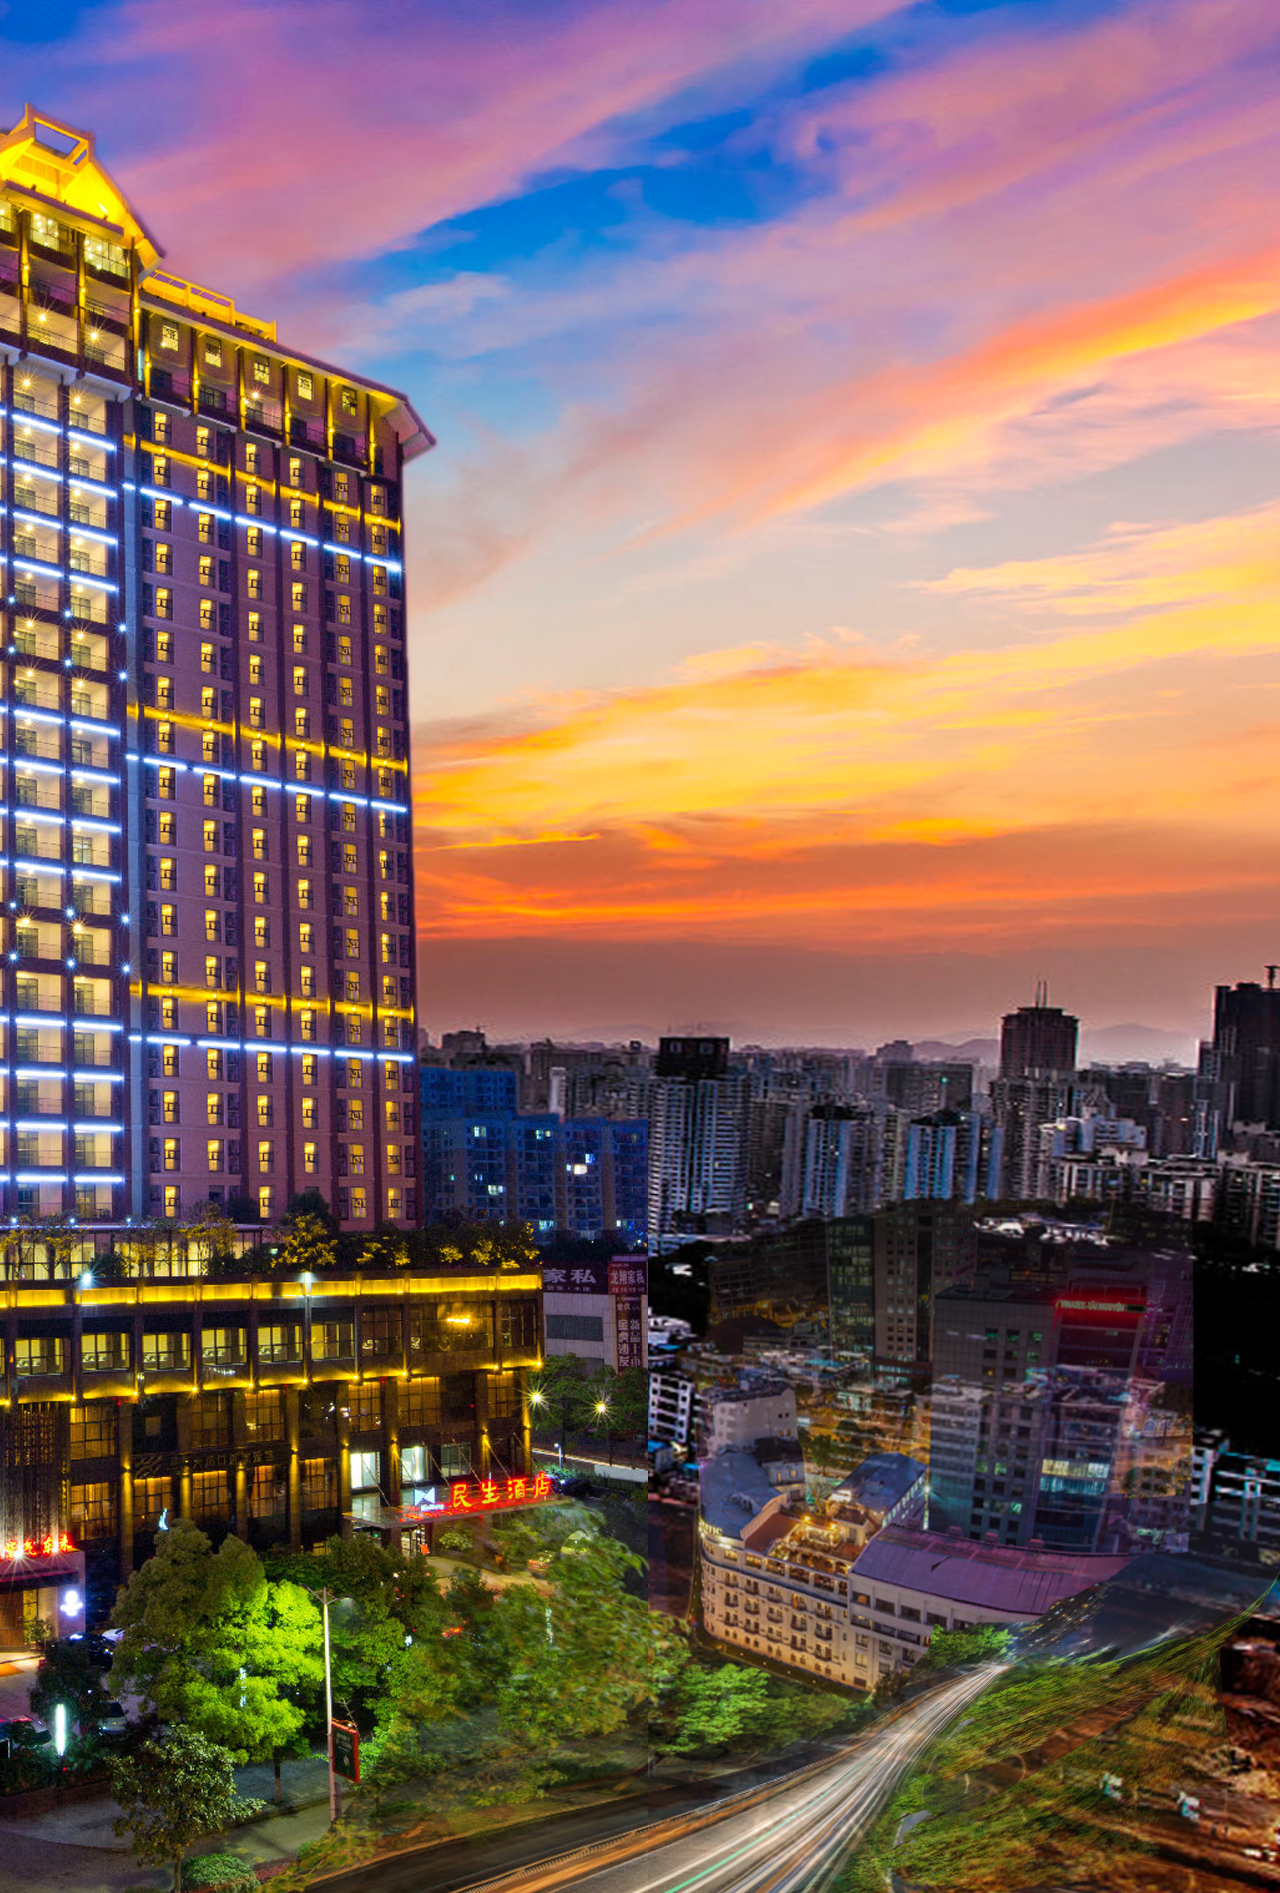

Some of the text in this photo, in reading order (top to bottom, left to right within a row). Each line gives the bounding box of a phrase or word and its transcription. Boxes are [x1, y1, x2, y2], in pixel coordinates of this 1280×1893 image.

[543, 1268, 597, 1284] 家私
[452, 1472, 552, 1508] 民生酒店
